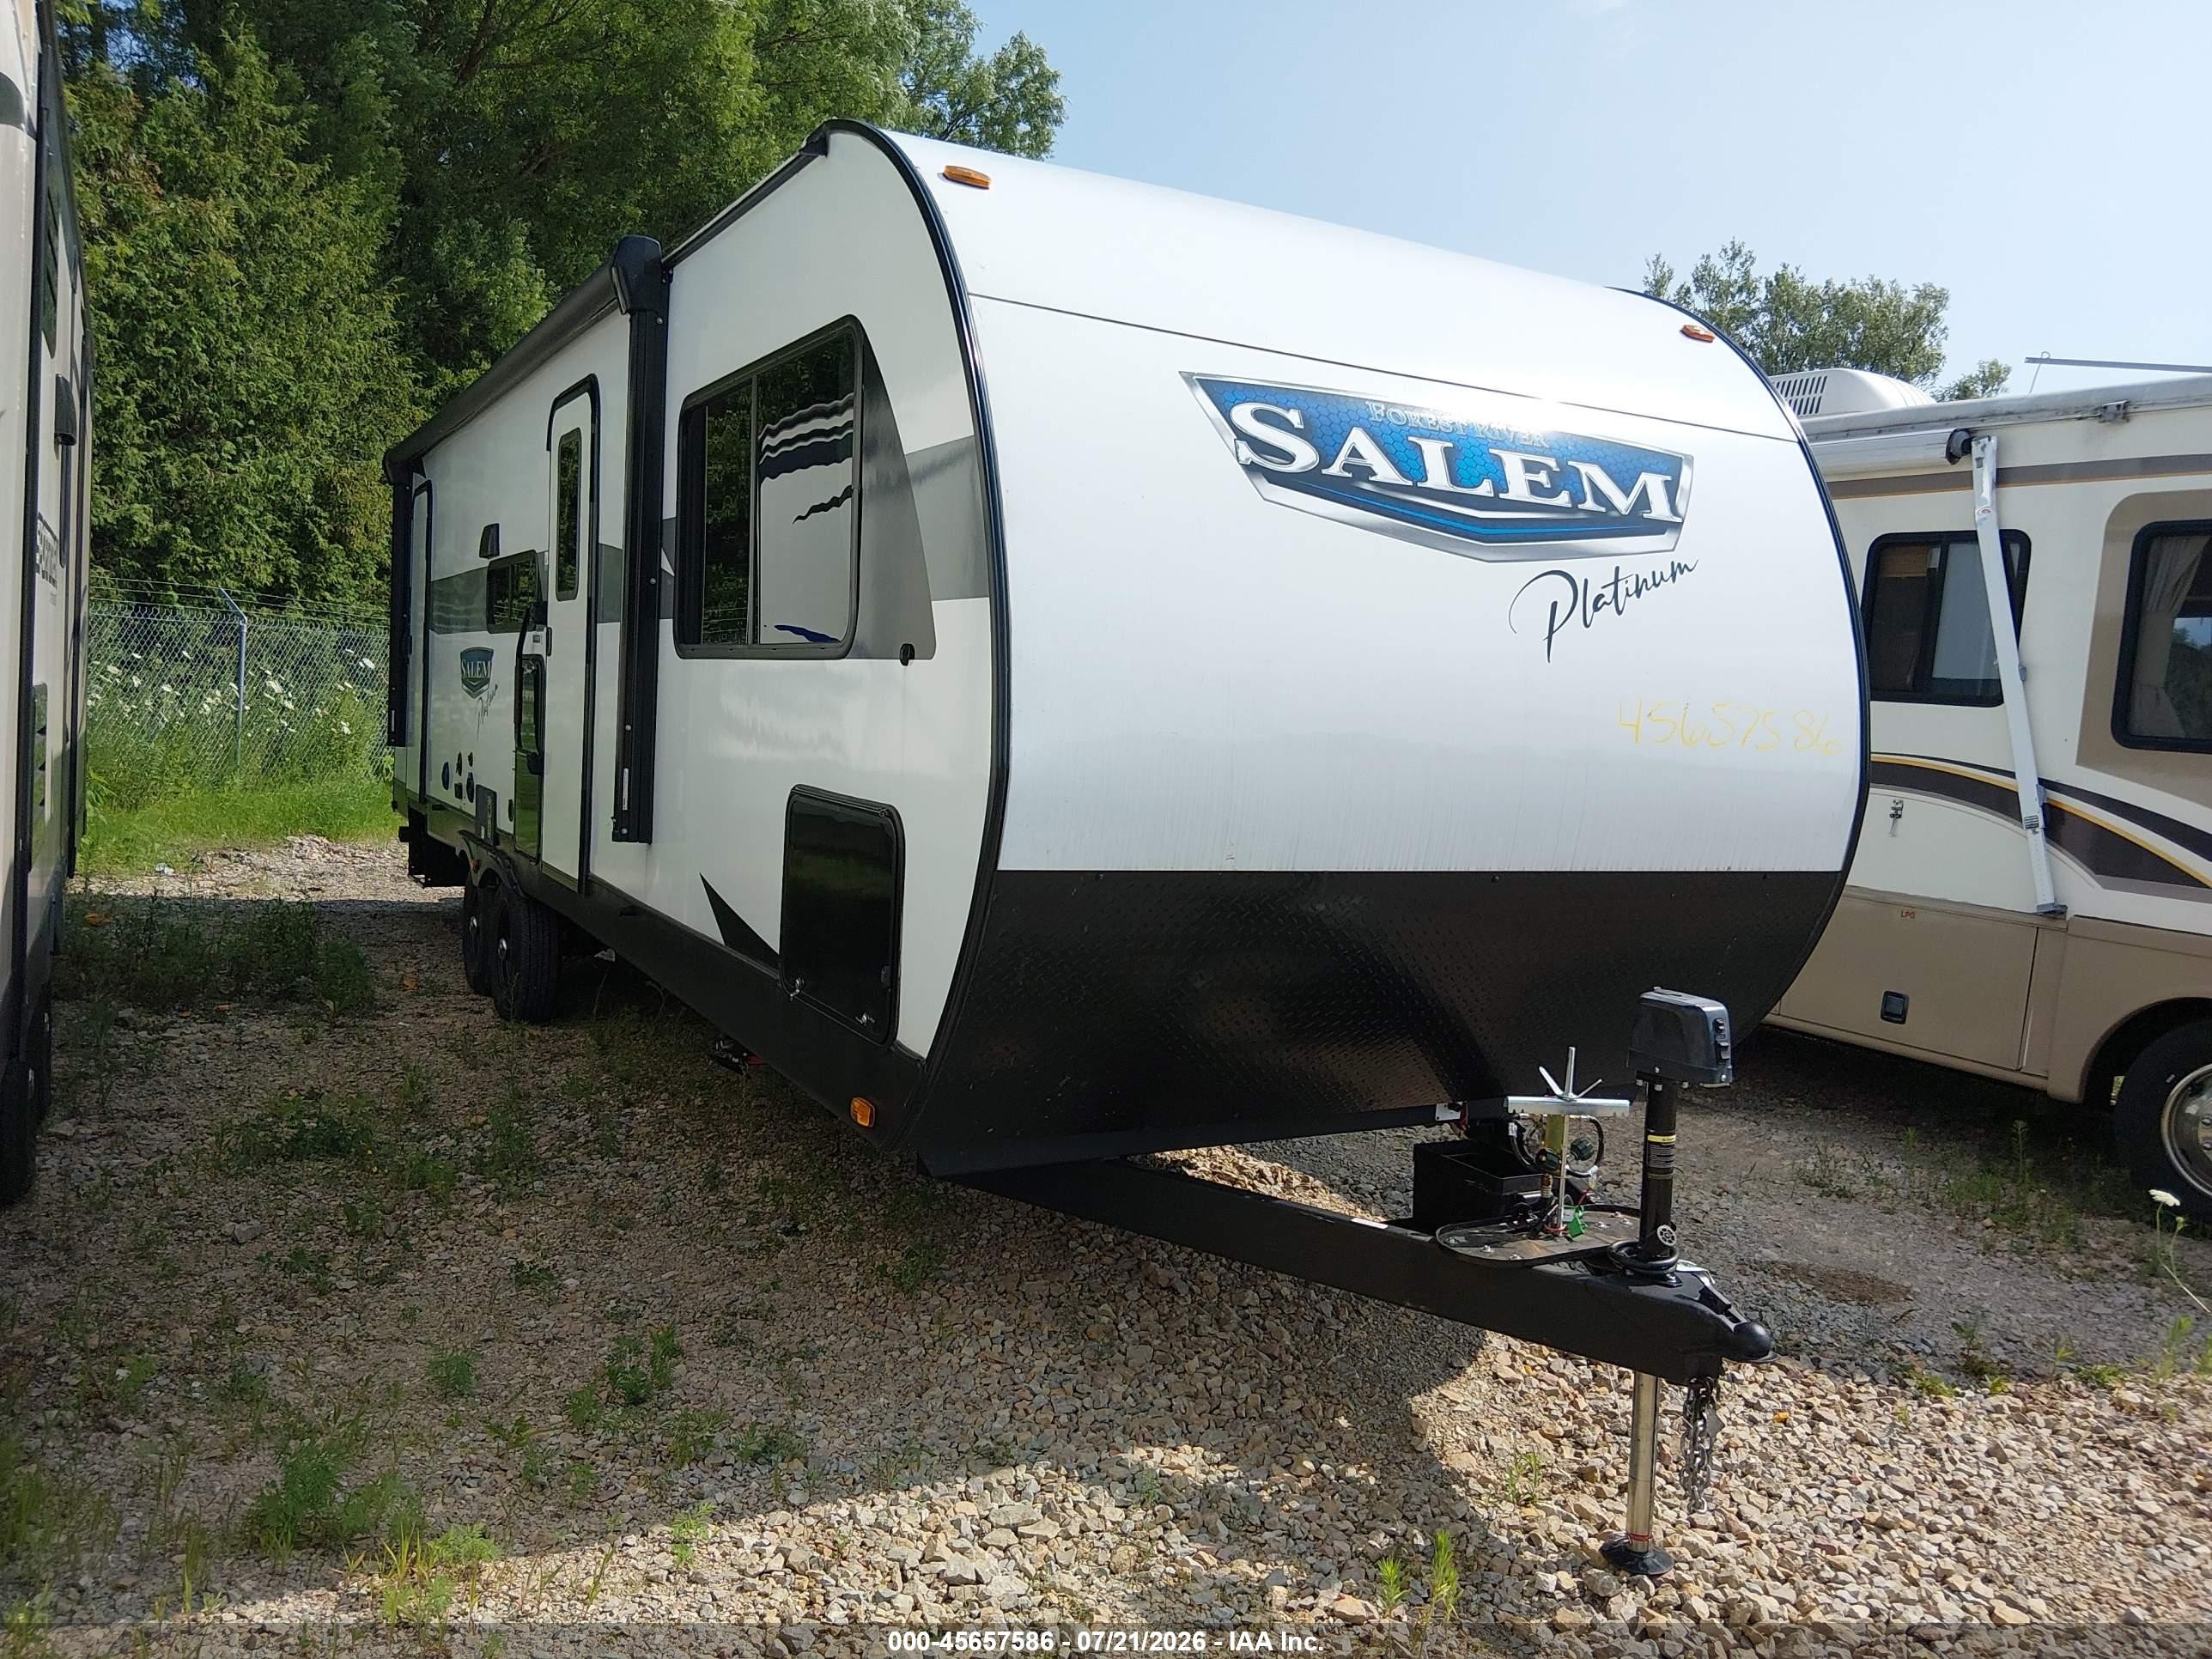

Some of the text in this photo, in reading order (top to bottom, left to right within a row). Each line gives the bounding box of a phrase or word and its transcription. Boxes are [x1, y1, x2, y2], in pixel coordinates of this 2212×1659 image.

[1229, 401, 1683, 523] SALEM
[1365, 400, 1550, 448] FOREST RIVER
[1508, 558, 1698, 663] Platinum
[461, 659, 491, 679] SALEM
